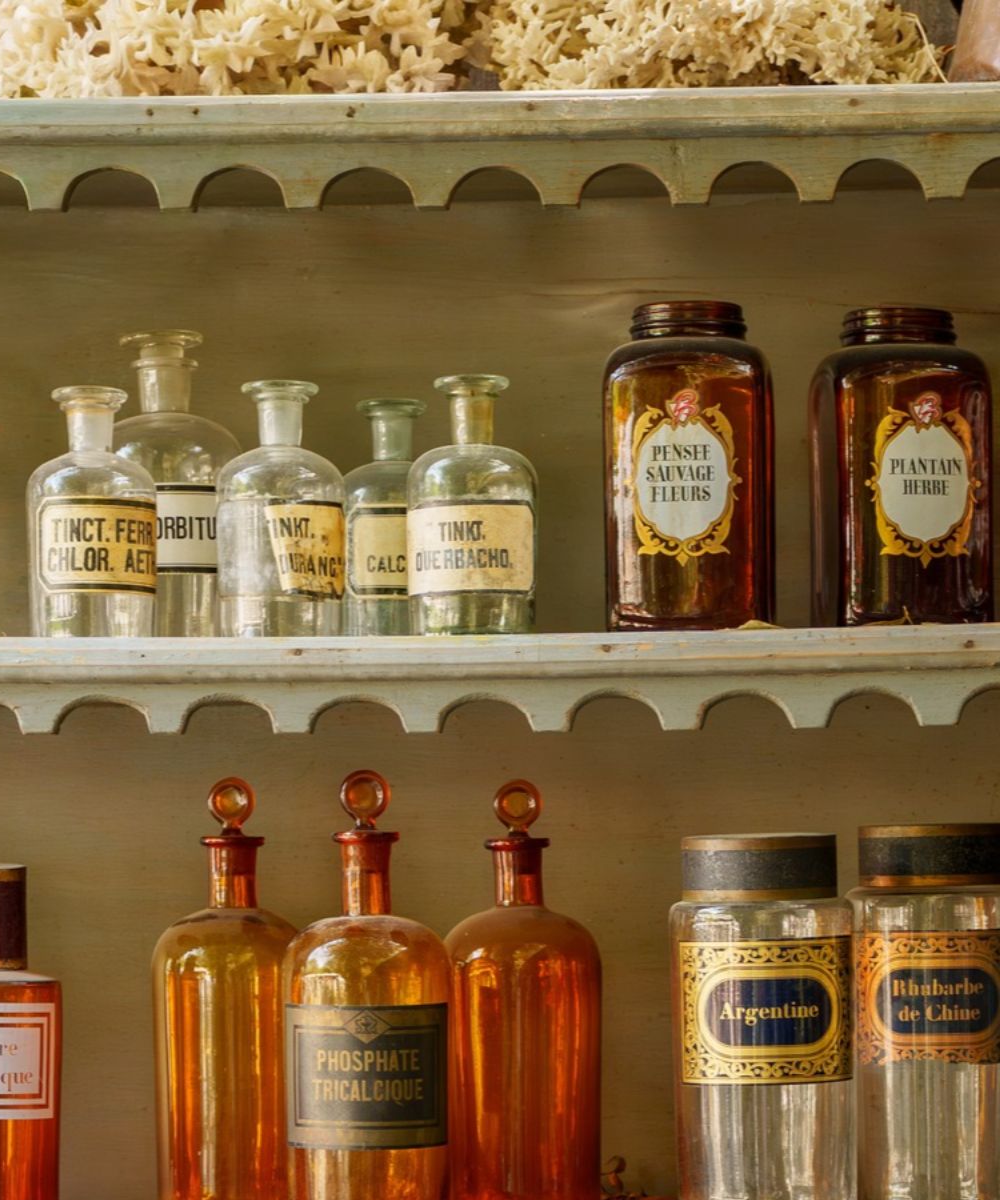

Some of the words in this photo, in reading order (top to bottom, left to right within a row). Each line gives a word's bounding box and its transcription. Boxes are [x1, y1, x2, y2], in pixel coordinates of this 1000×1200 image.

[651, 443, 712, 461] PENSEE
[646, 464, 716, 482] SAUVAGE
[888, 457, 963, 476] PLANTAIN
[650, 485, 712, 503] FLEURS
[902, 479, 950, 496] HERBE
[51, 517, 110, 543] TINCT.
[267, 516, 316, 540] INKT.
[437, 520, 486, 542] TINKT.
[47, 546, 114, 573] CHLOR.
[892, 977, 985, 997] Rhubarbe
[719, 1001, 820, 1027] Argentine
[898, 1004, 921, 1022] de
[925, 1003, 981, 1022] Chine
[316, 1049, 421, 1073] PHOSPHATE
[310, 1078, 425, 1107] TRICALCIQUE
